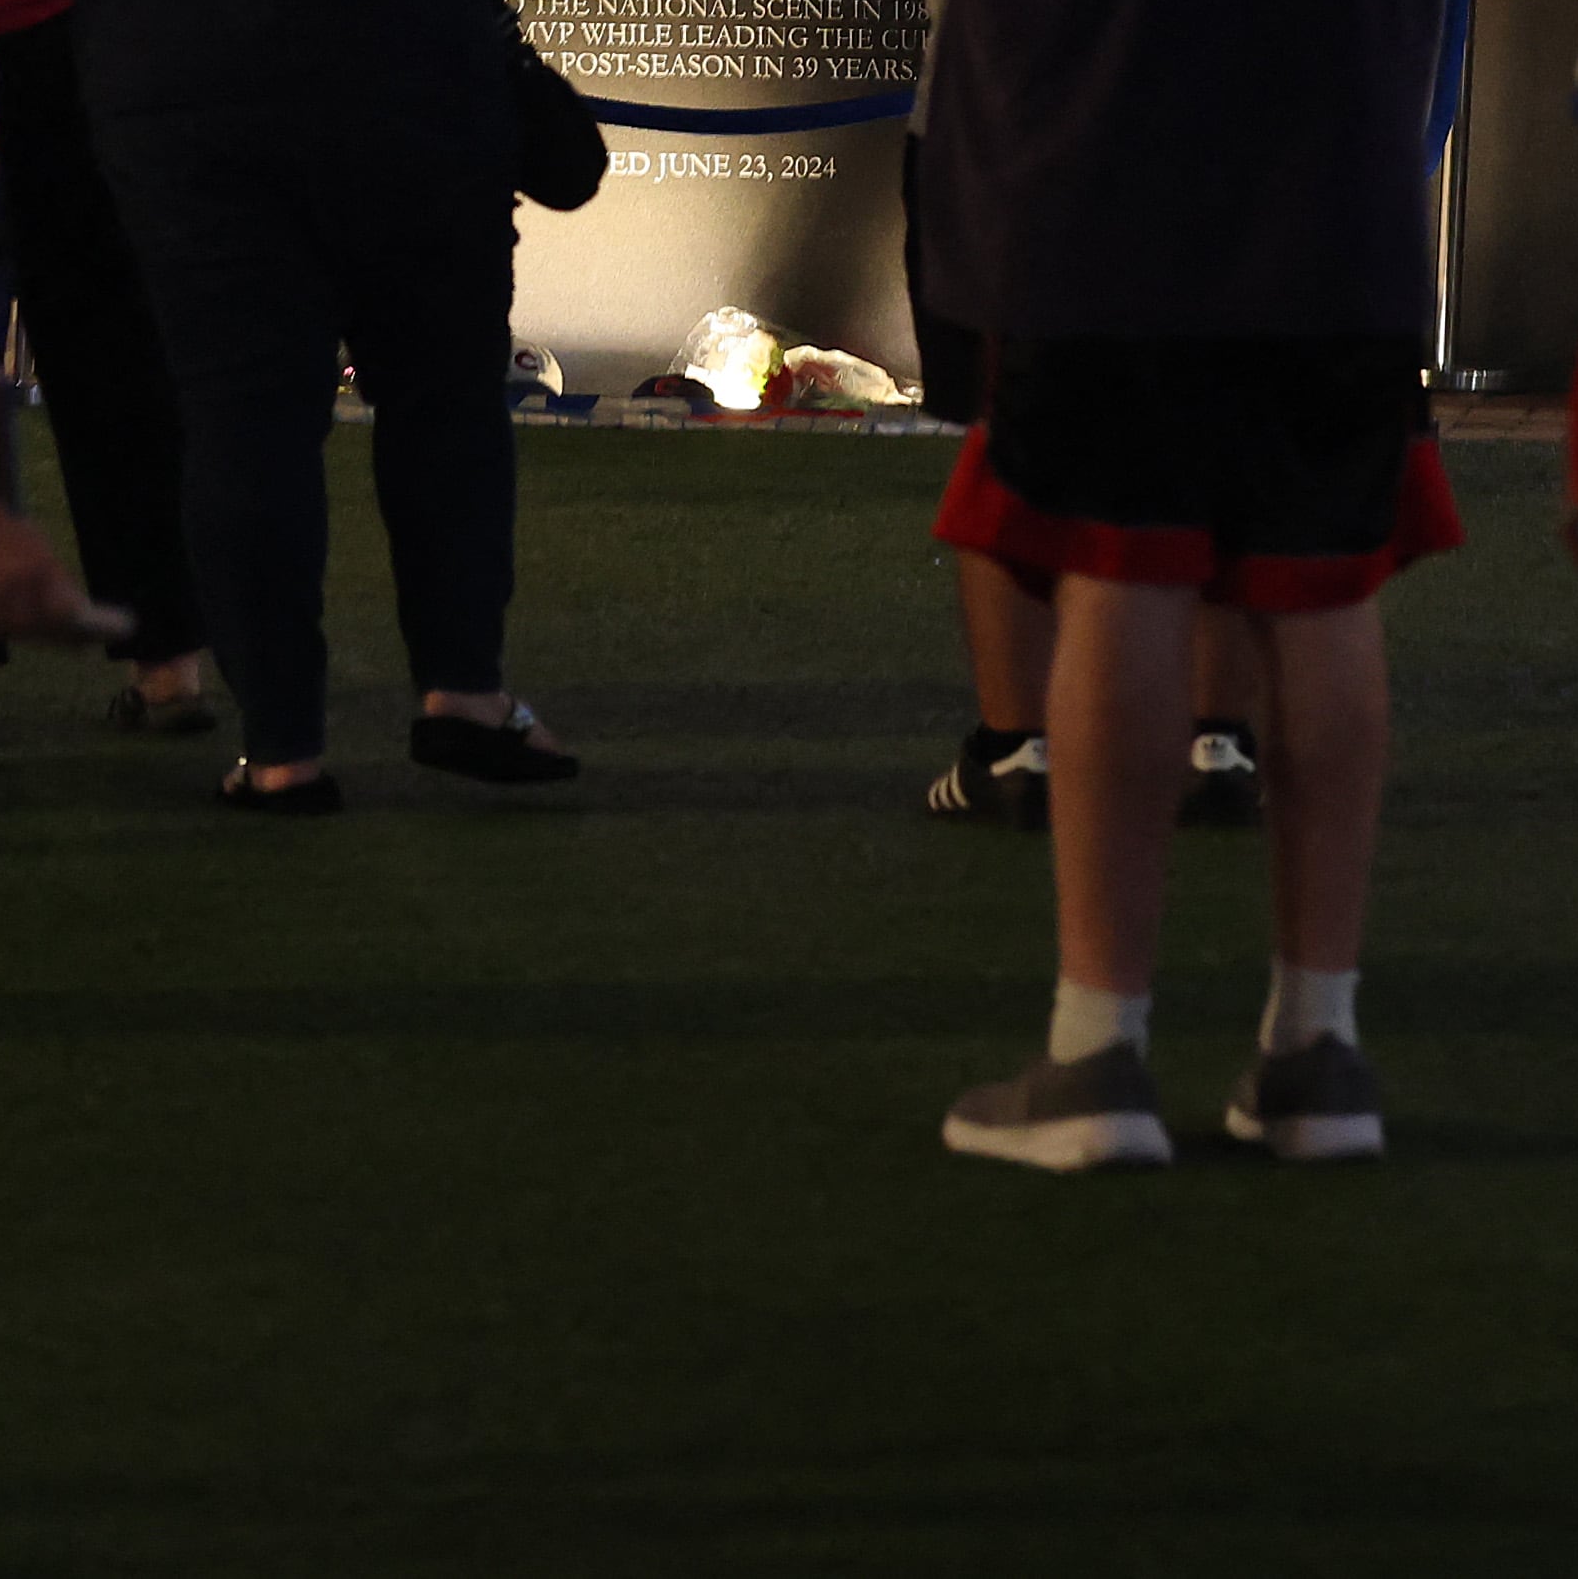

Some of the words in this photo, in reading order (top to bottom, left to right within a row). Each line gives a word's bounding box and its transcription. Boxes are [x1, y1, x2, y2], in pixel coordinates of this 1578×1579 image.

[854, 0, 882, 22] IN
[894, 0, 930, 23] 198
[517, 21, 575, 45] MVP
[580, 22, 673, 47] WHILE
[680, 24, 809, 49] LEADING
[816, 27, 874, 50] THE
[881, 28, 928, 51] CU
[560, 51, 745, 79] POST-SEASON
[752, 55, 785, 79] IN
[792, 56, 819, 80] 39
[826, 57, 919, 82] YEARS.
[653, 152, 732, 183] JUNE
[739, 154, 774, 183] 23,
[780, 155, 837, 180] 2024
